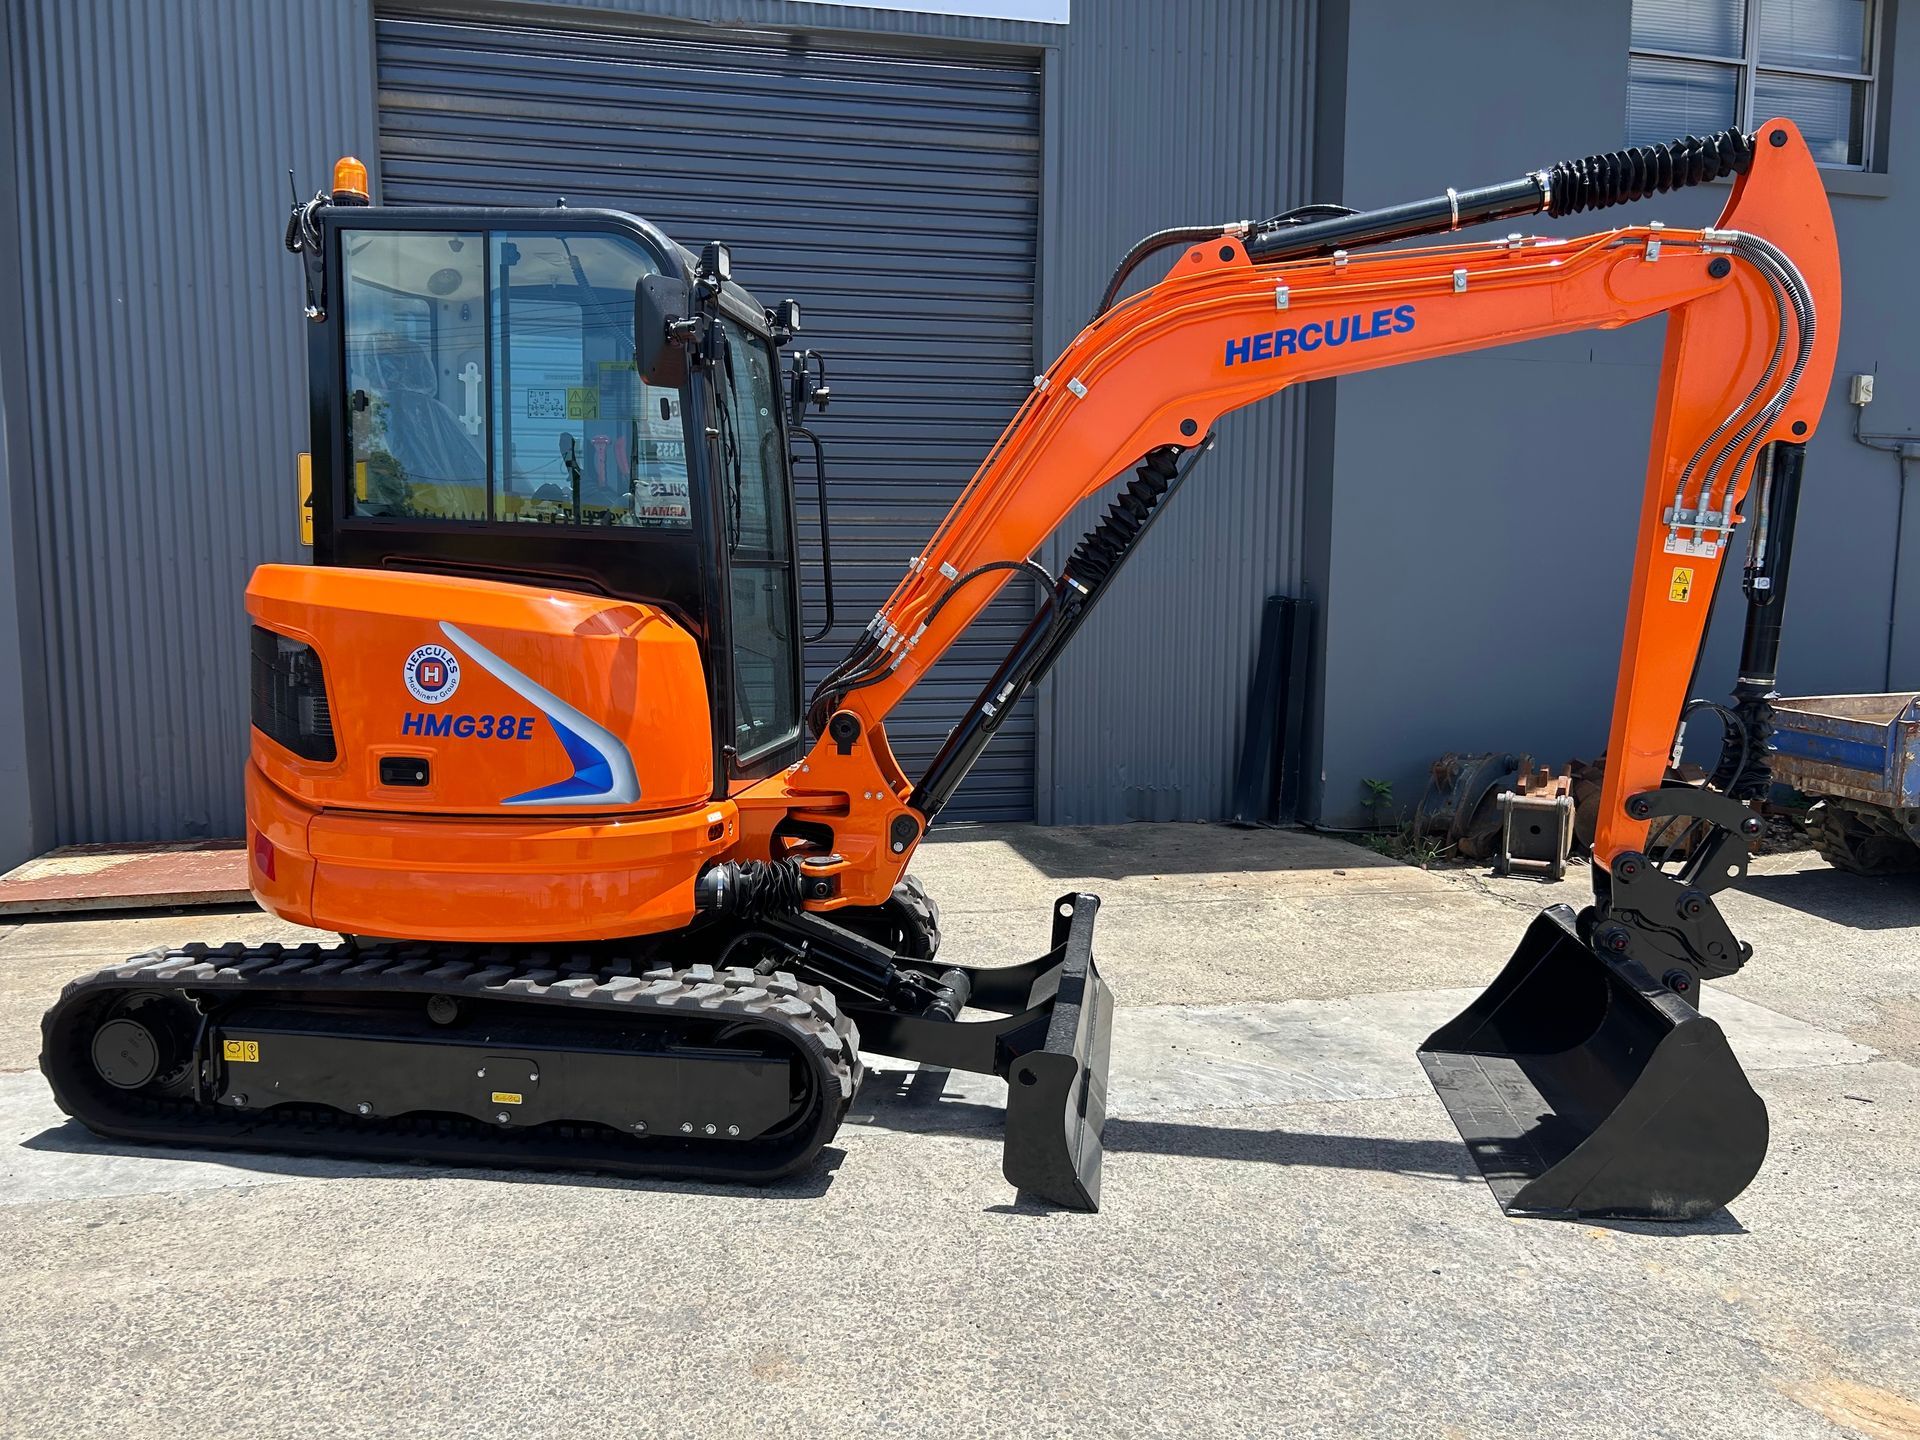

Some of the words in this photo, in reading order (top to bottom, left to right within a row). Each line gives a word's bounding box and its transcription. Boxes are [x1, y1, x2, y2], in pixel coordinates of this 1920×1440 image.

[1224, 304, 1416, 367] HERCULES
[406, 647, 458, 674] HERCULES
[424, 666, 439, 682] H
[408, 676, 438, 701] Machinery
[439, 678, 456, 698] Group
[402, 712, 536, 740] HMG38E
